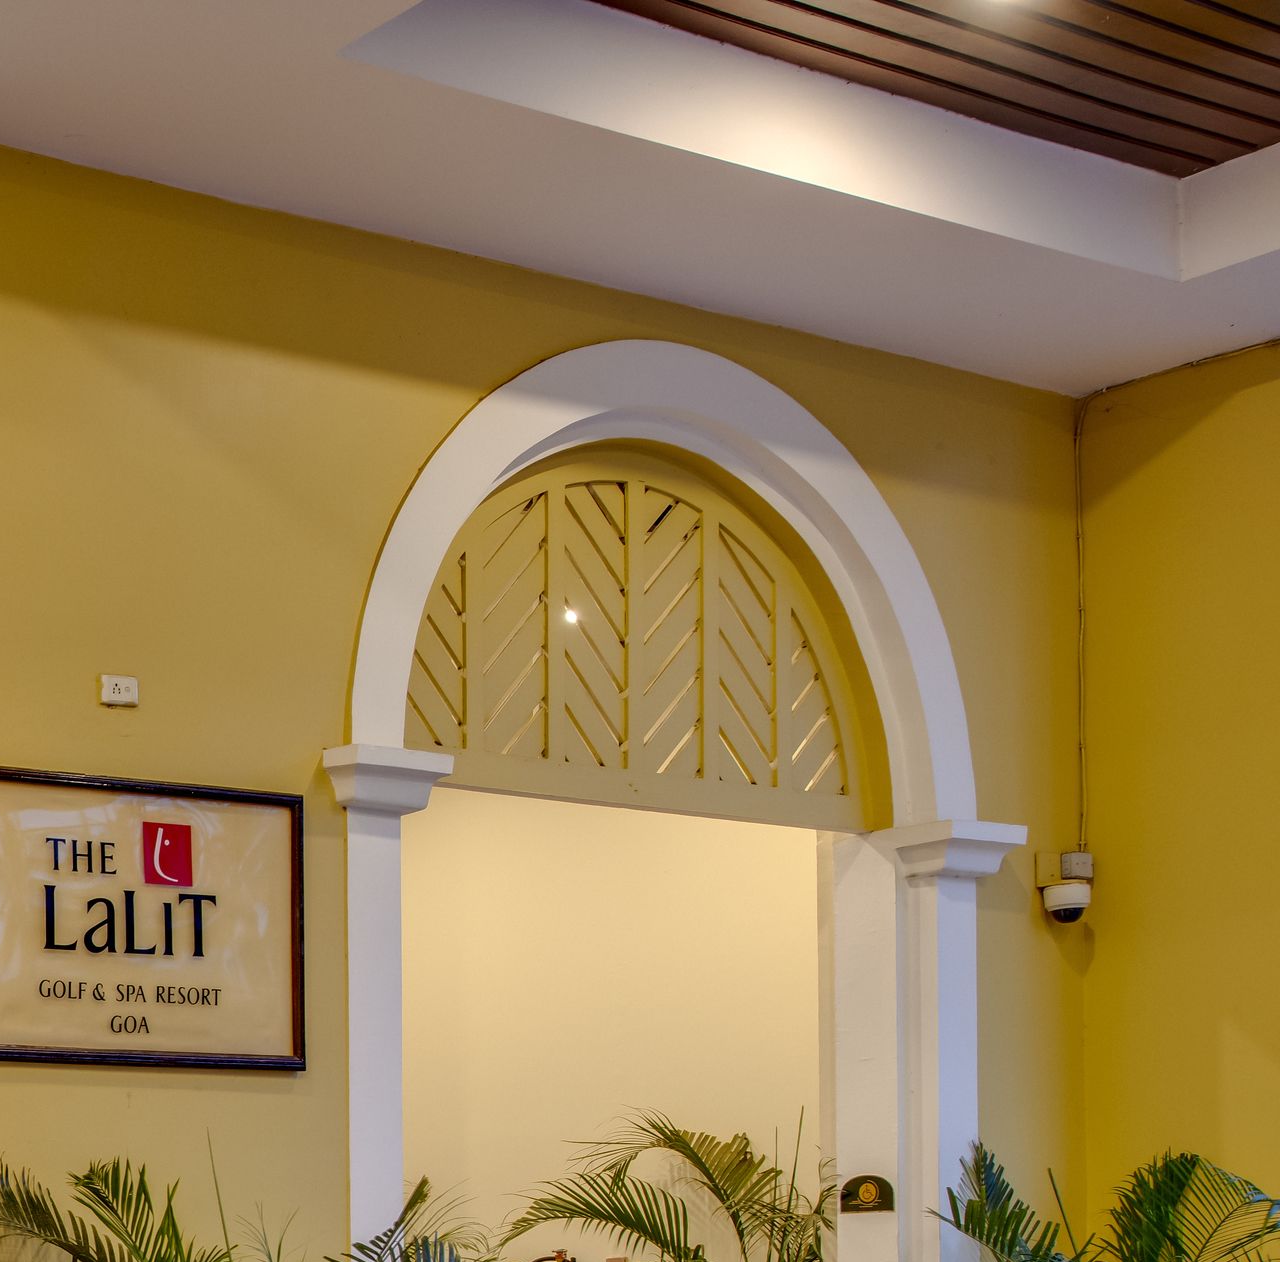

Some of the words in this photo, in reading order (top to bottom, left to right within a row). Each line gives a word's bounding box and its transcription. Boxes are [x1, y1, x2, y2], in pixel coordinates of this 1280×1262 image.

[45, 837, 117, 875] THE
[38, 979, 87, 1000] GOLF
[92, 982, 106, 1001] &
[115, 983, 147, 1003] SPA
[156, 985, 222, 1006] RESORT
[110, 1015, 150, 1034] GOA
